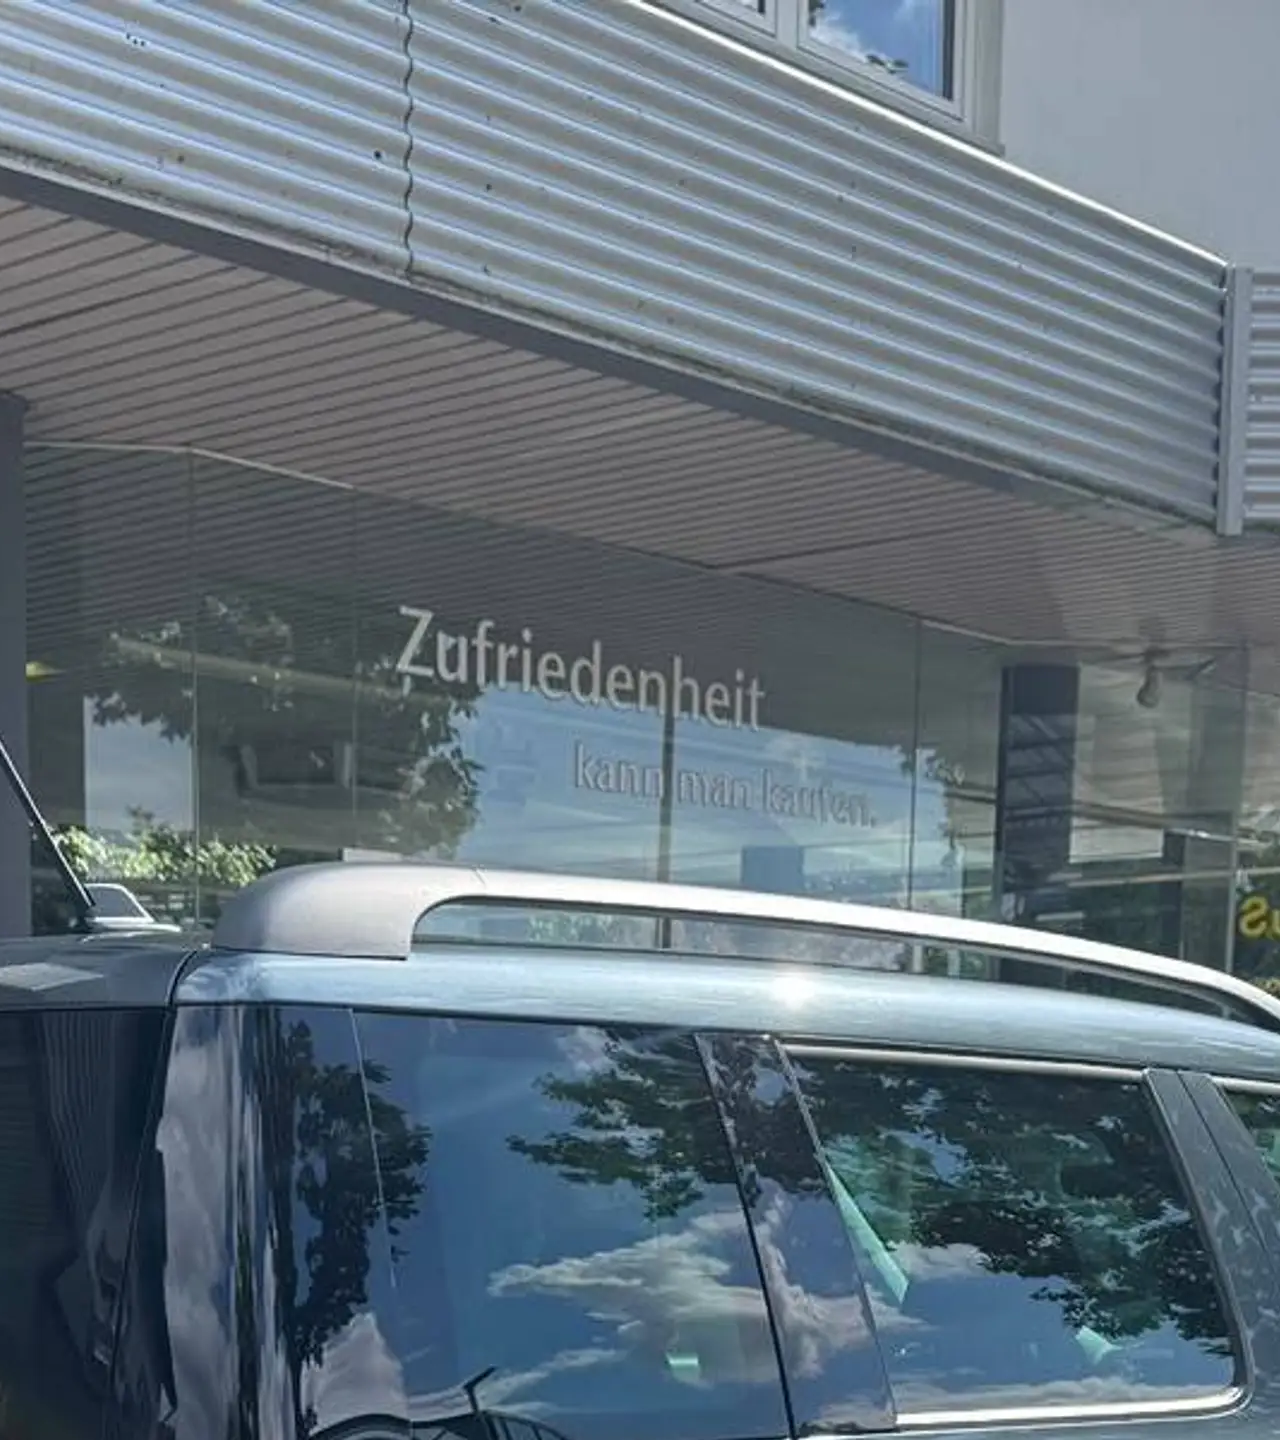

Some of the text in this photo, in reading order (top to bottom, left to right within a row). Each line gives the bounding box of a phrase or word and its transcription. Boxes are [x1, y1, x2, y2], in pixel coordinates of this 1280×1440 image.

[397, 605, 765, 732] Zufriedenheit
[575, 742, 878, 829] kann man kaufen.
